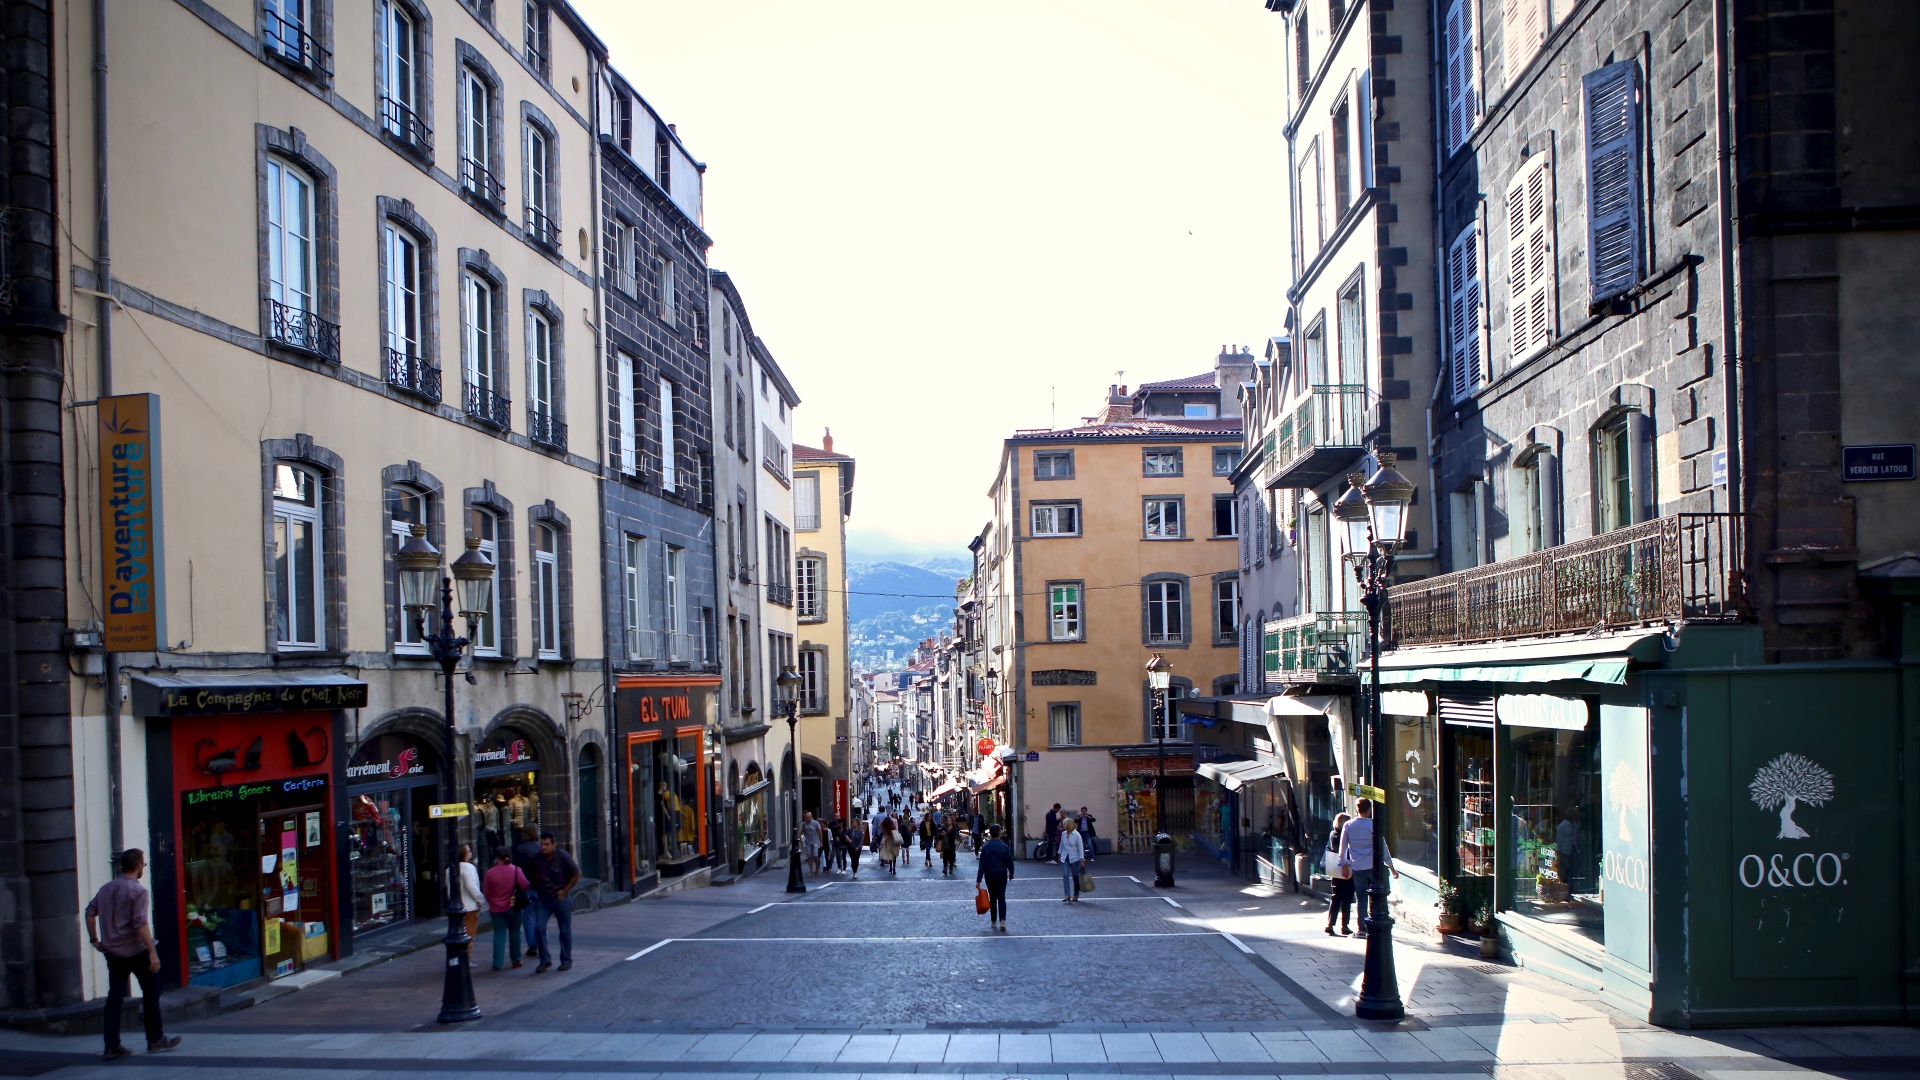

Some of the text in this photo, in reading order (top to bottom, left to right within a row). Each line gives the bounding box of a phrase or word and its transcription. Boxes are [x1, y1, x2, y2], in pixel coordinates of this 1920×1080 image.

[1871, 452, 1885, 461] RUE
[1849, 464, 1908, 475] VERDIER LATOUR
[109, 443, 133, 615] D'aventure
[123, 441, 149, 601] aventure
[110, 623, 149, 632] trek rando
[110, 635, 135, 644] voyage
[168, 686, 363, 711] La Compagnie du Chat Noir
[640, 696, 659, 723] EL
[389, 747, 424, 778] Soie
[475, 747, 506, 763] arrément
[1128, 769, 1168, 777] SURPLUS
[283, 778, 325, 792] Carterie
[188, 784, 271, 805] Librairie Sonore
[1739, 852, 1849, 888] O&CO.
